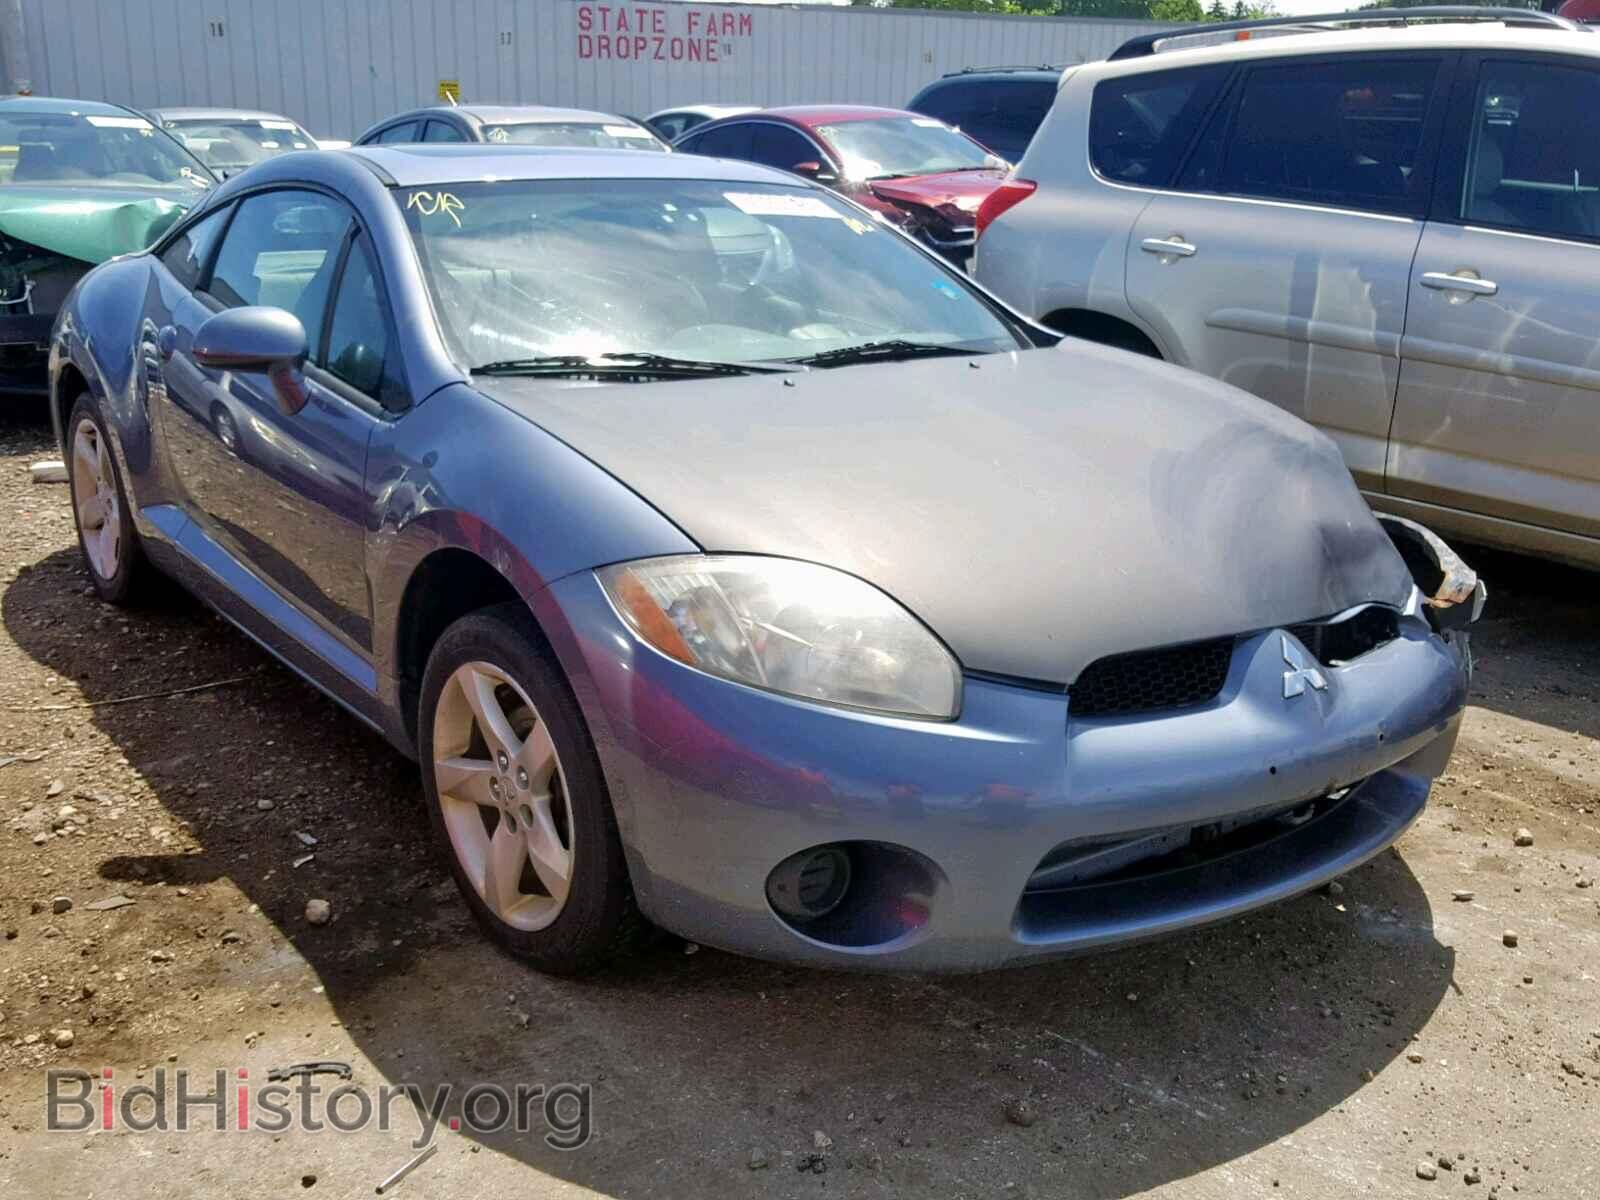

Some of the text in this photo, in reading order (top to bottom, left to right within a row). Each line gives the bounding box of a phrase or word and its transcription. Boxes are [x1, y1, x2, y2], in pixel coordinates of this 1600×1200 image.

[578, 6, 753, 37] STATE FARM
[578, 34, 719, 62] DROPZONE
